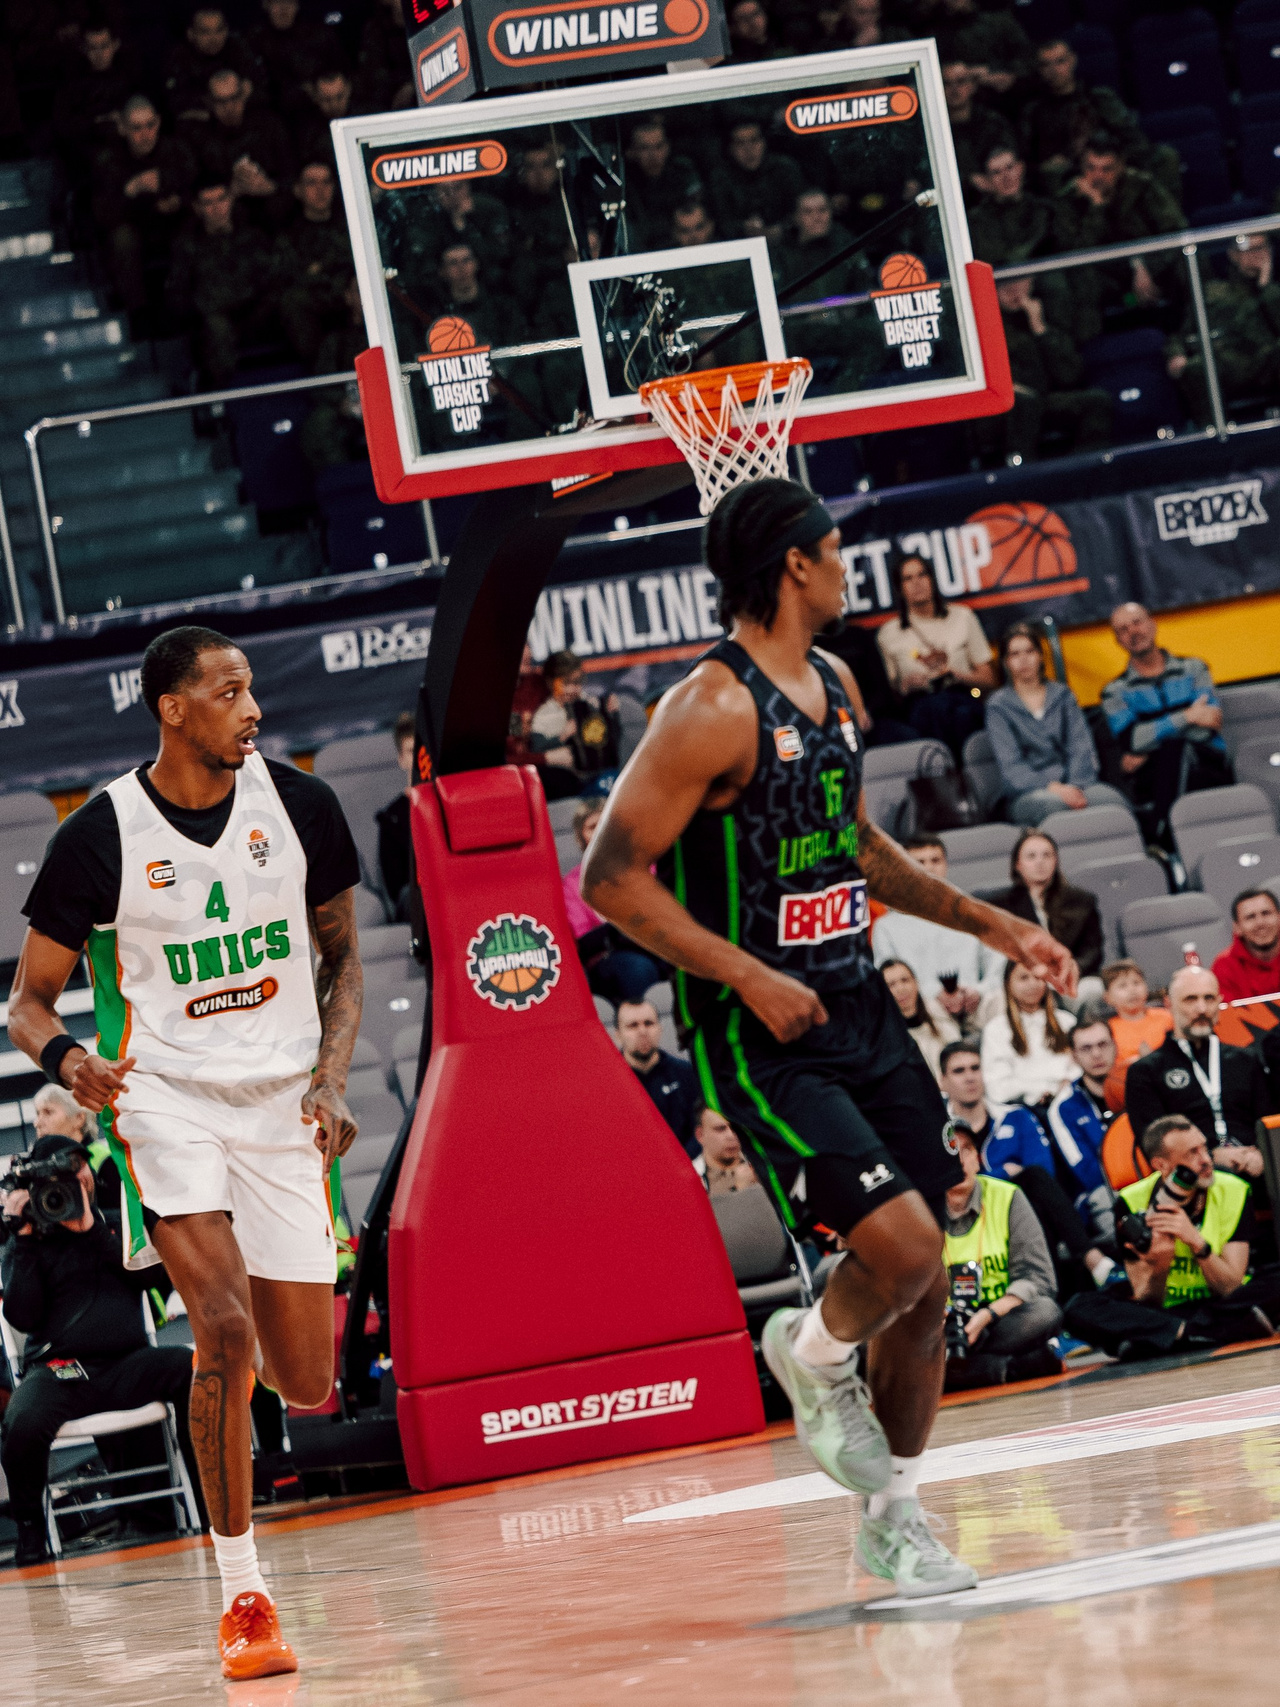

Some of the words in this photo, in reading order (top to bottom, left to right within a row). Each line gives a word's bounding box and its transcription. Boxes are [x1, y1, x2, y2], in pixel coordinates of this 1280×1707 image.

[505, 3, 659, 55] WINLINE
[796, 95, 889, 128] WINLINE
[382, 149, 477, 183] WINLINE
[874, 289, 943, 321] WINLINE
[884, 314, 940, 346] BASKET
[422, 352, 493, 386] WINLINE
[901, 341, 932, 369] CUP
[432, 378, 490, 411] BASKET
[451, 405, 482, 433] CUP
[527, 567, 725, 663] WINLINE
[153, 867, 175, 881] WIN
[205, 880, 230, 922] 4
[163, 919, 291, 985] UNICS
[478, 946, 549, 981] УРАЛМАШ
[193, 988, 263, 1017] WINLINE
[481, 1399, 579, 1435] SPORT
[581, 1377, 698, 1423] SYSTEM
